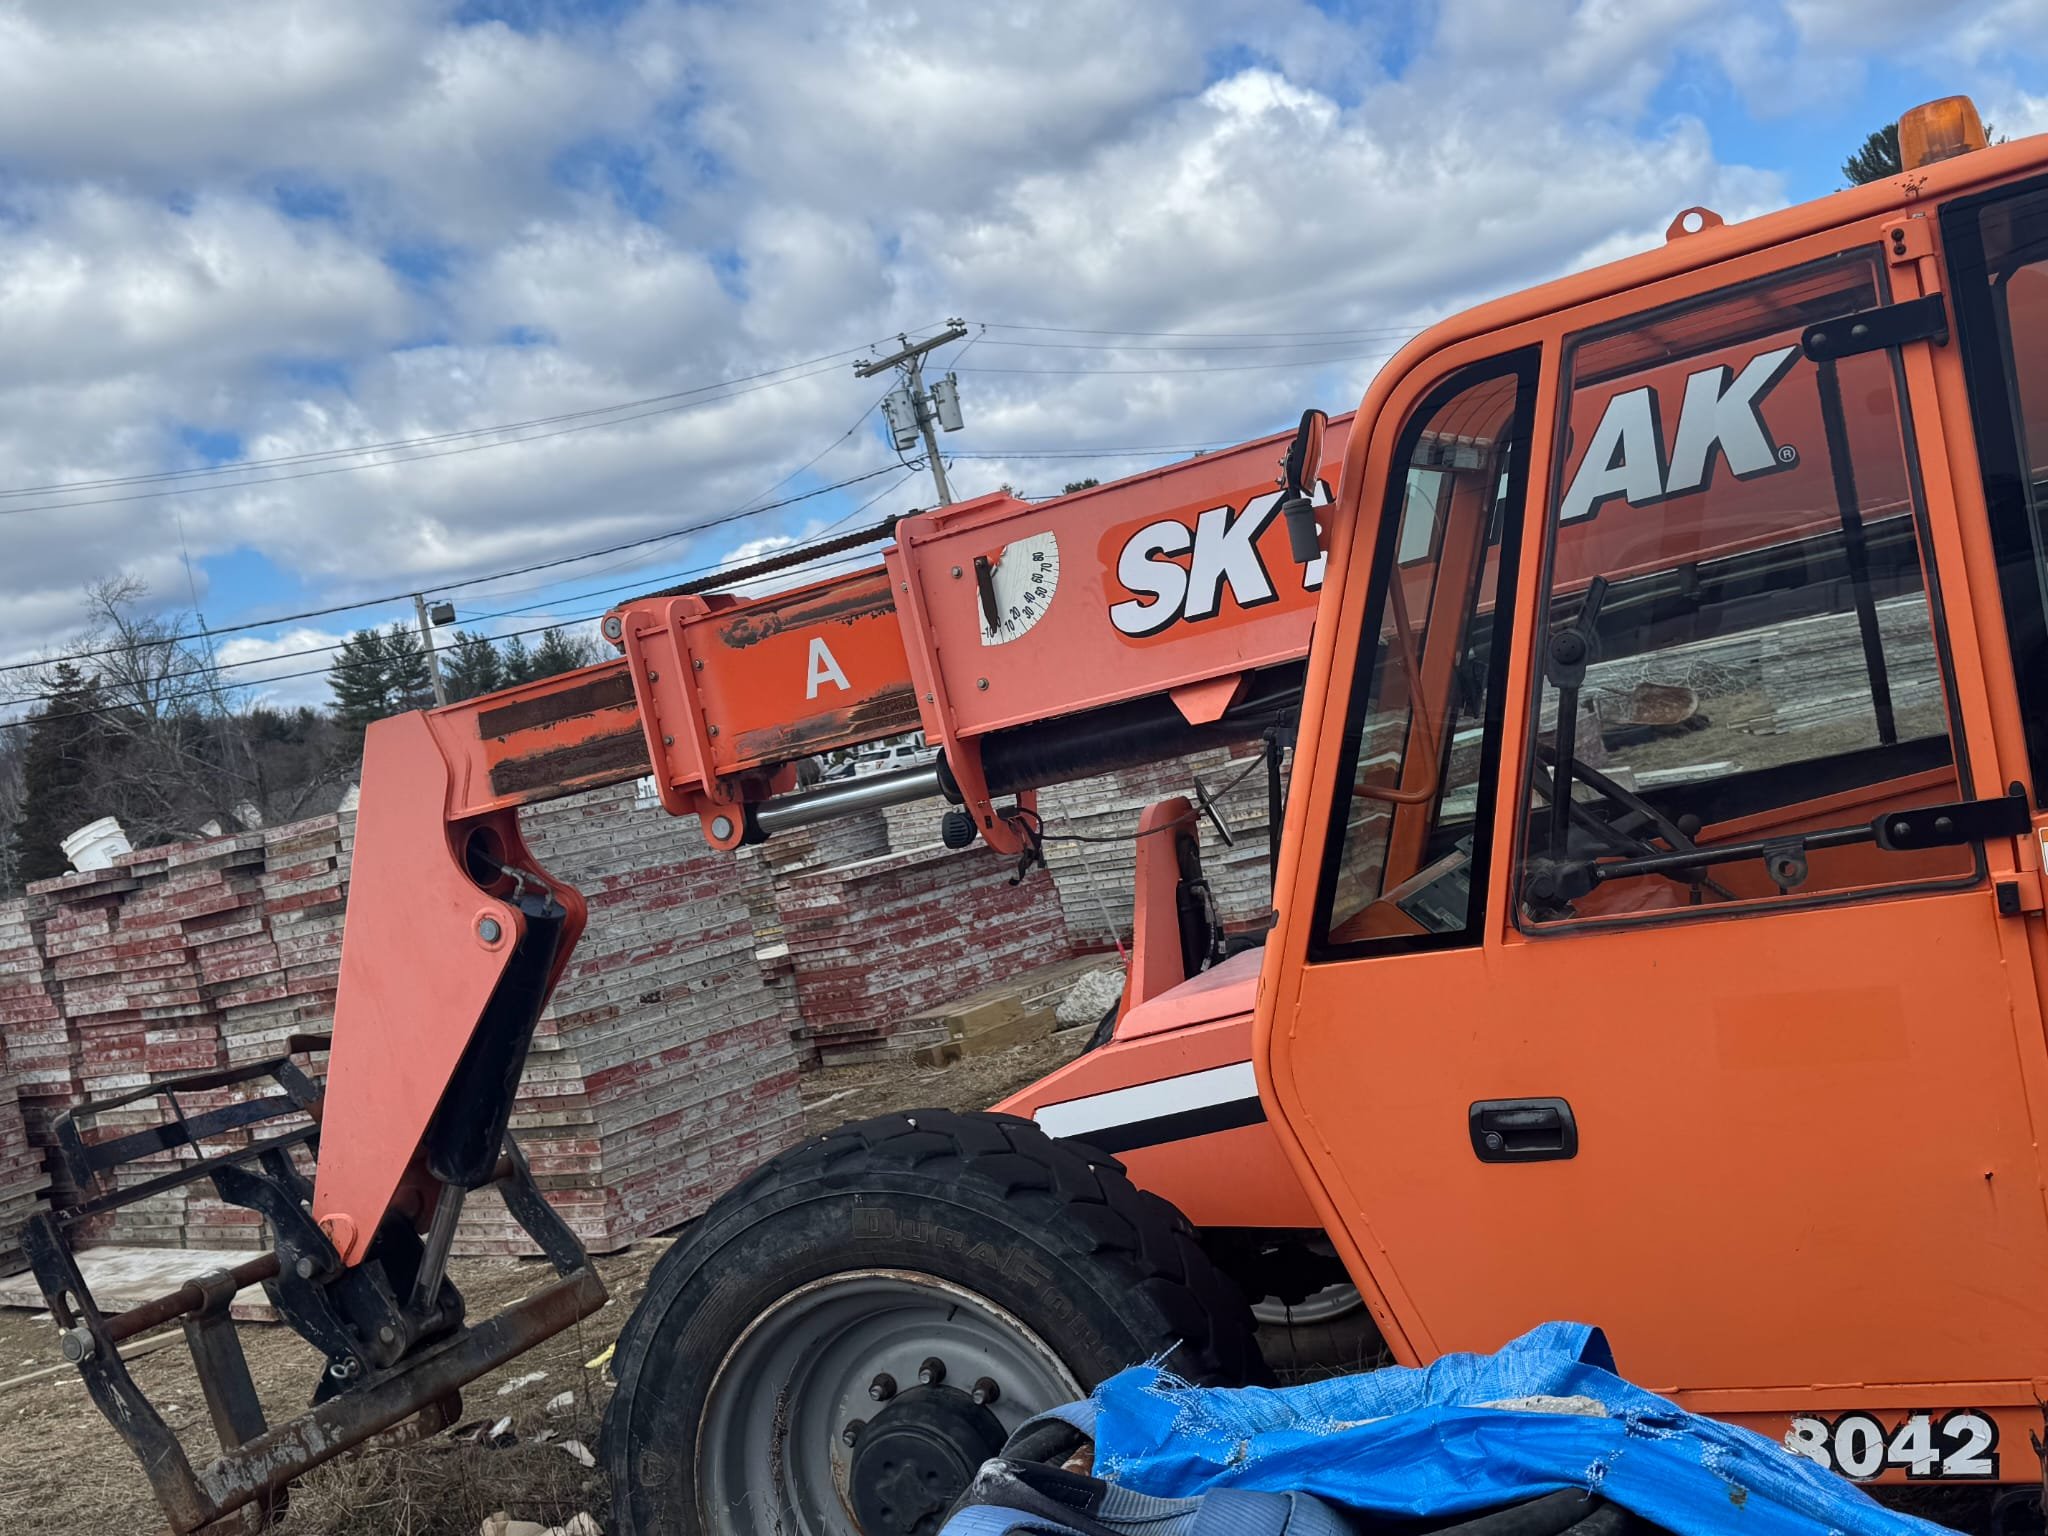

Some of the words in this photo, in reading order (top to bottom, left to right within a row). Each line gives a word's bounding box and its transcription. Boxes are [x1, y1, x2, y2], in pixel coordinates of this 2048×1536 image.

[1032, 551, 1044, 562] 80
[1040, 562, 1053, 573] 70
[1031, 573, 1044, 584] 60
[1023, 591, 1036, 604] 40
[1034, 586, 1048, 599] 50
[1009, 606, 1021, 620] 20
[1022, 605, 1035, 619] 30
[1004, 619, 1015, 632] 10
[806, 636, 852, 700] A
[1784, 1410, 1998, 1480] 8042
